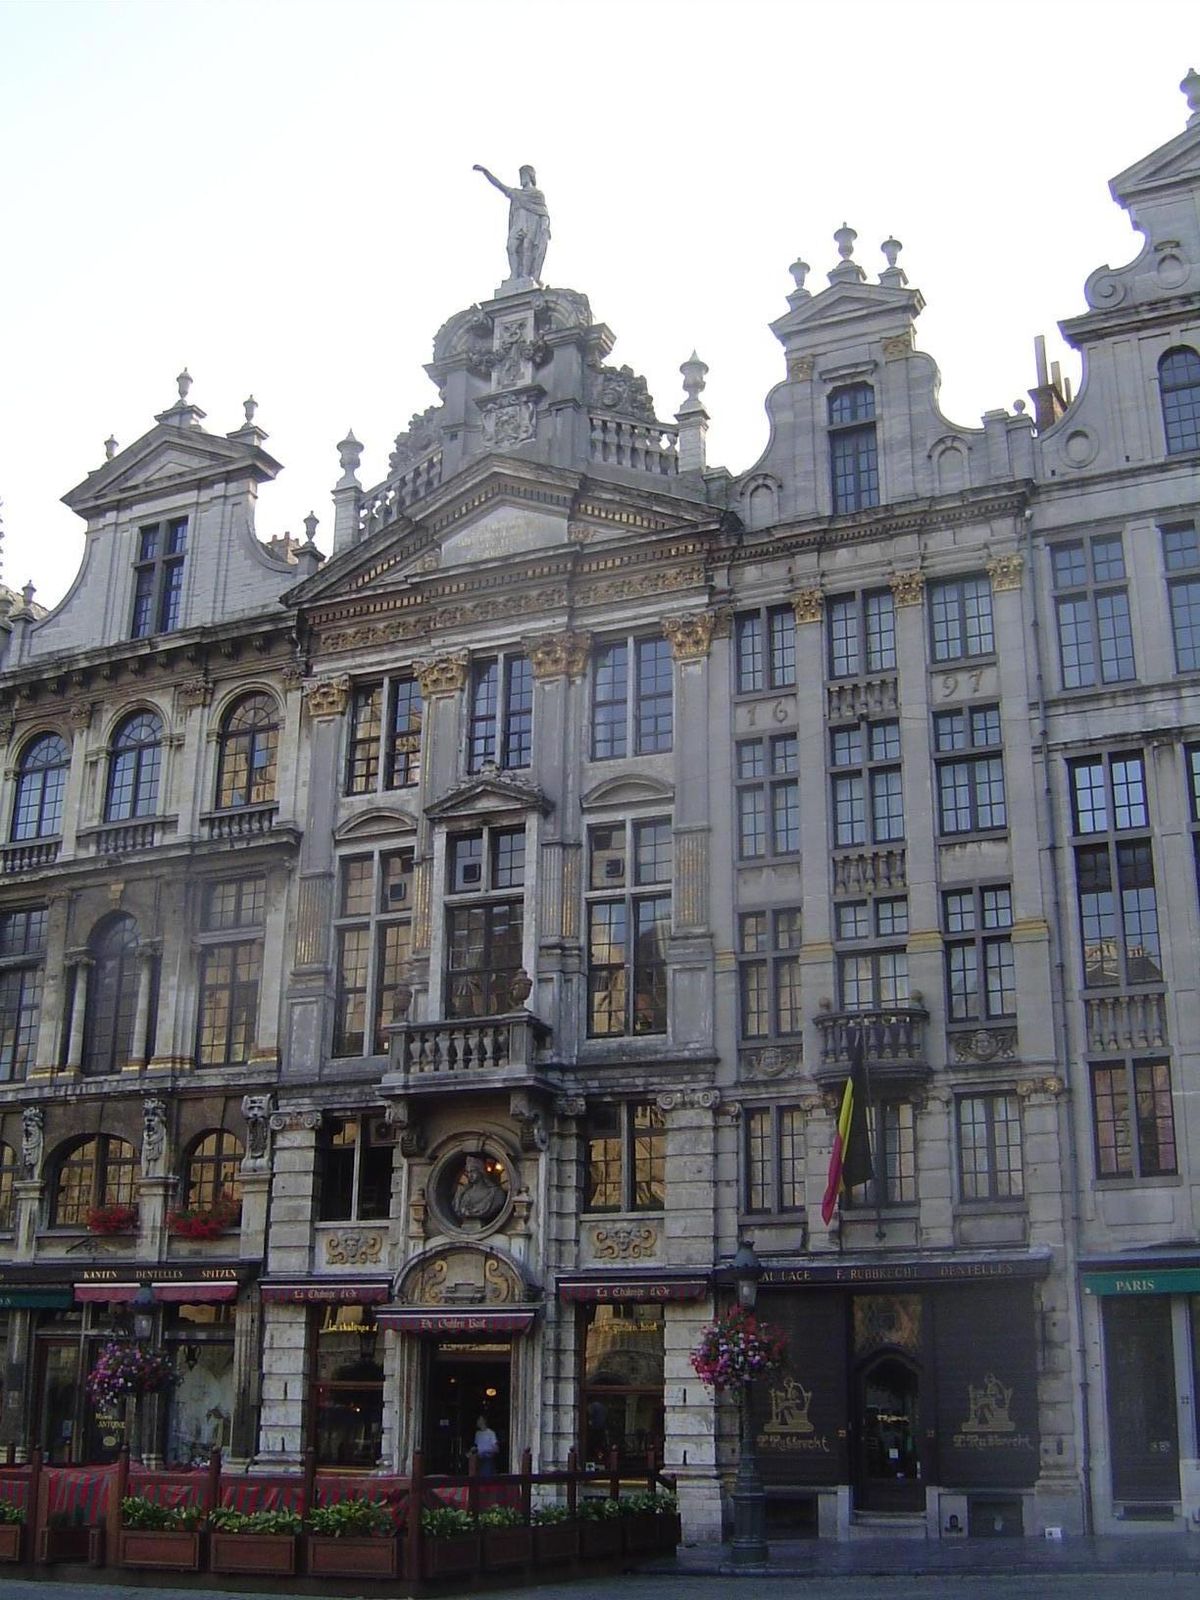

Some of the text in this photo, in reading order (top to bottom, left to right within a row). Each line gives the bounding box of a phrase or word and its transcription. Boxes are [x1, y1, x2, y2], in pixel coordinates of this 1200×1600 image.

[83, 1270, 118, 1280] KANTEN
[135, 1270, 183, 1279] DENTELLES
[201, 1269, 237, 1278] SPITZEN
[782, 1270, 811, 1280] LACE
[1115, 1280, 1155, 1291] PARIS
